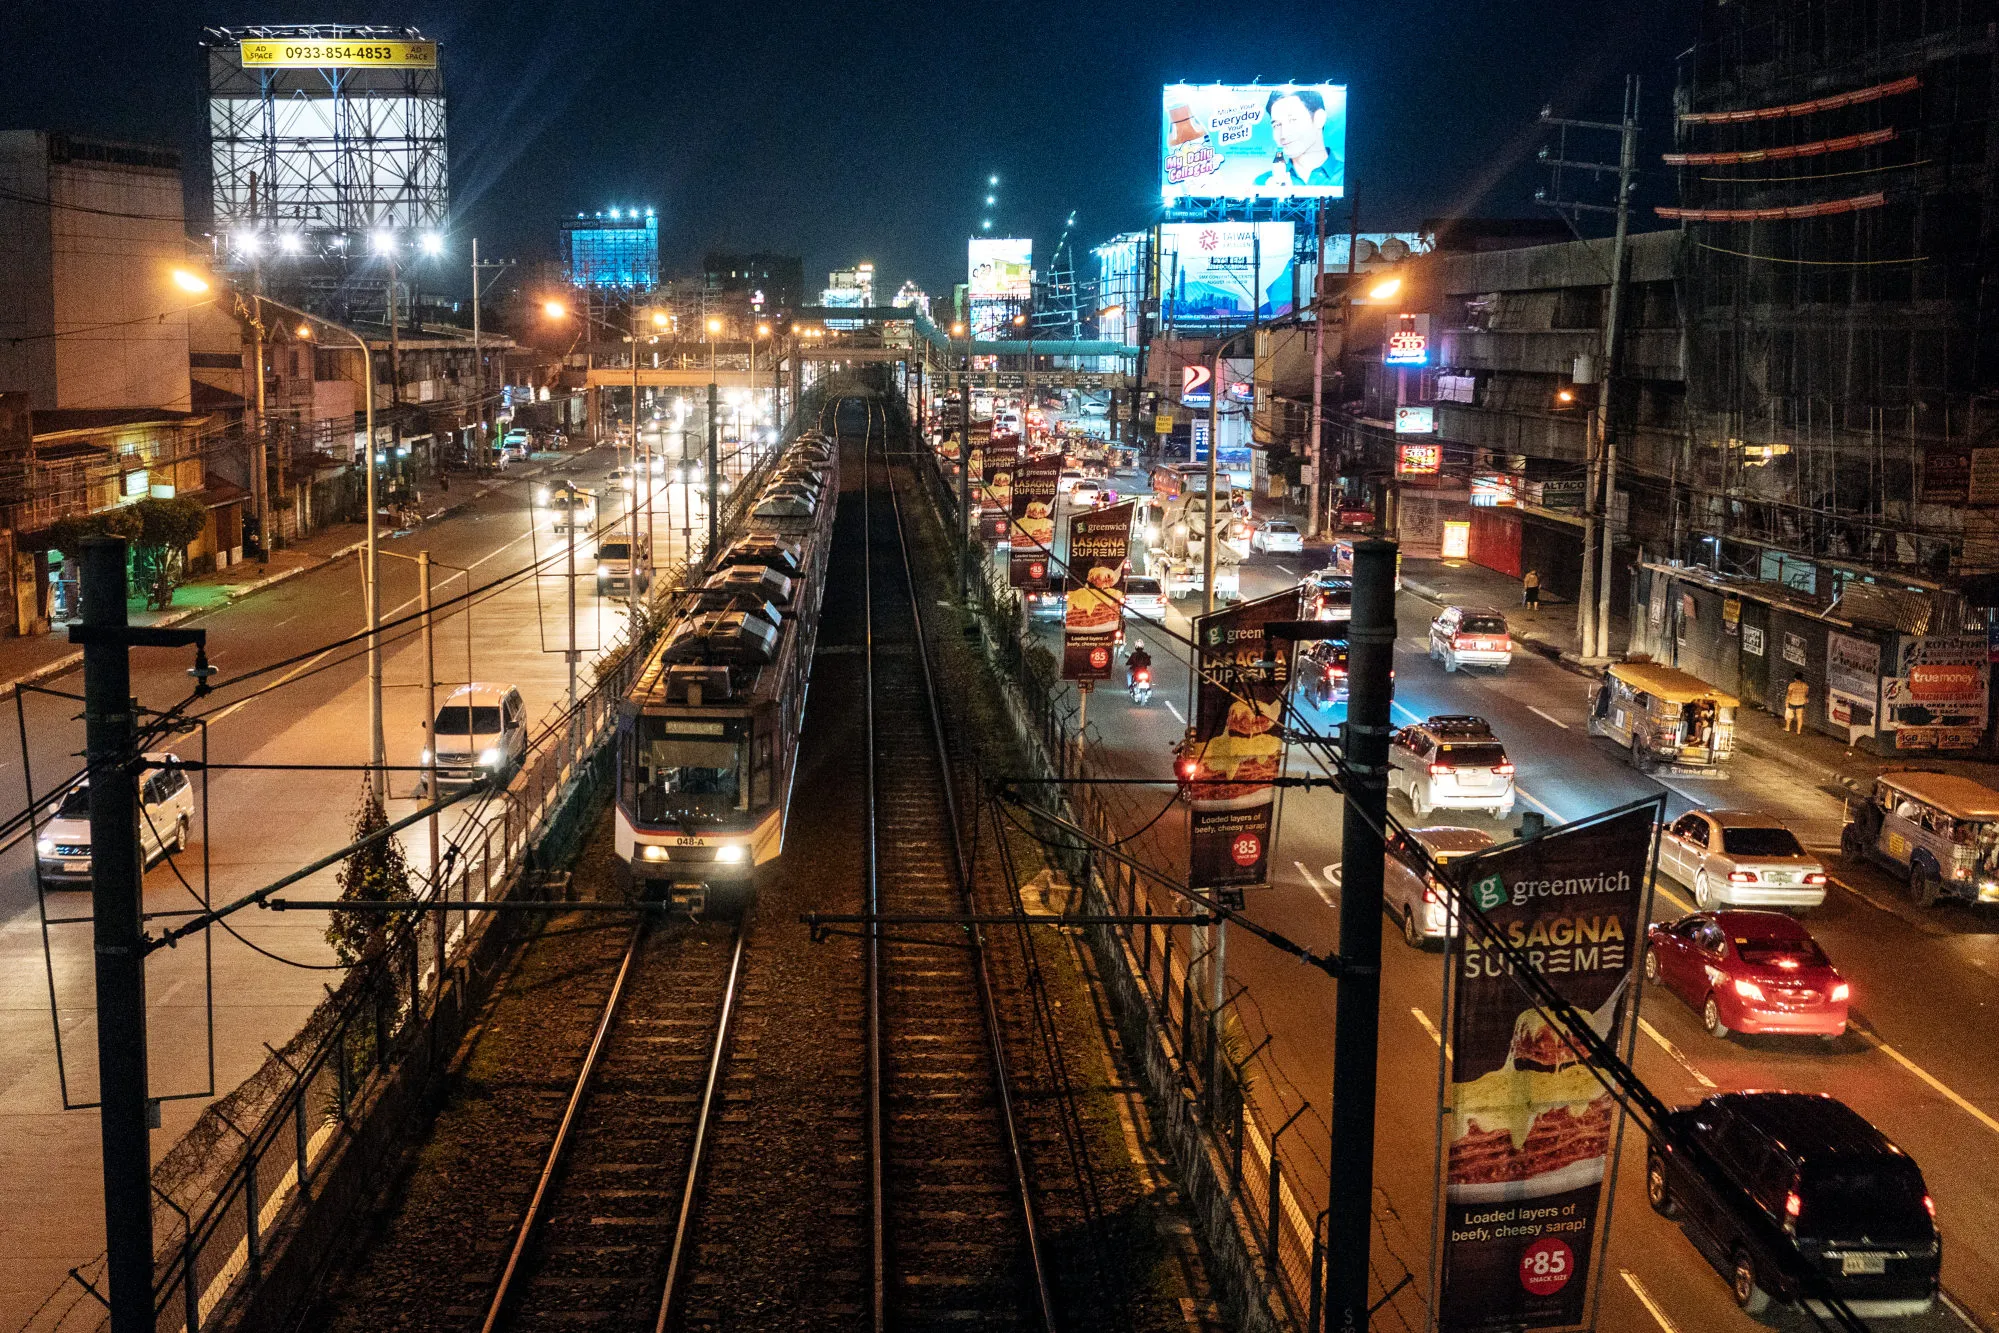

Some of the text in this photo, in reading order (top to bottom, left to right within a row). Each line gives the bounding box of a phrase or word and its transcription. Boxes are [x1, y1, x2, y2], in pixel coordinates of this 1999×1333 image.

[250, 53, 273, 61] SPACE
[286, 47, 392, 60] 0933-854-4853
[405, 53, 429, 62] SPACE
[1212, 111, 1260, 128] Everyday
[1222, 127, 1248, 142] Best!
[1166, 149, 1213, 170] My Daily
[1014, 480, 1056, 488] LASAGNA
[1088, 522, 1127, 533] greenwich
[1072, 537, 1125, 548] LASAGNA
[1072, 547, 1126, 557] SUPREME
[1227, 628, 1265, 644] green
[1201, 812, 1262, 824] Loaded layers of
[1217, 822, 1244, 832] cheesy
[677, 837, 704, 846] 048-A
[1478, 871, 1630, 910] g greenwich
[1464, 1203, 1576, 1225] Loaded layers of
[1451, 1217, 1587, 1242] beefy, cheesy sarap!
[1529, 1274, 1568, 1285] SNACK SIZE
